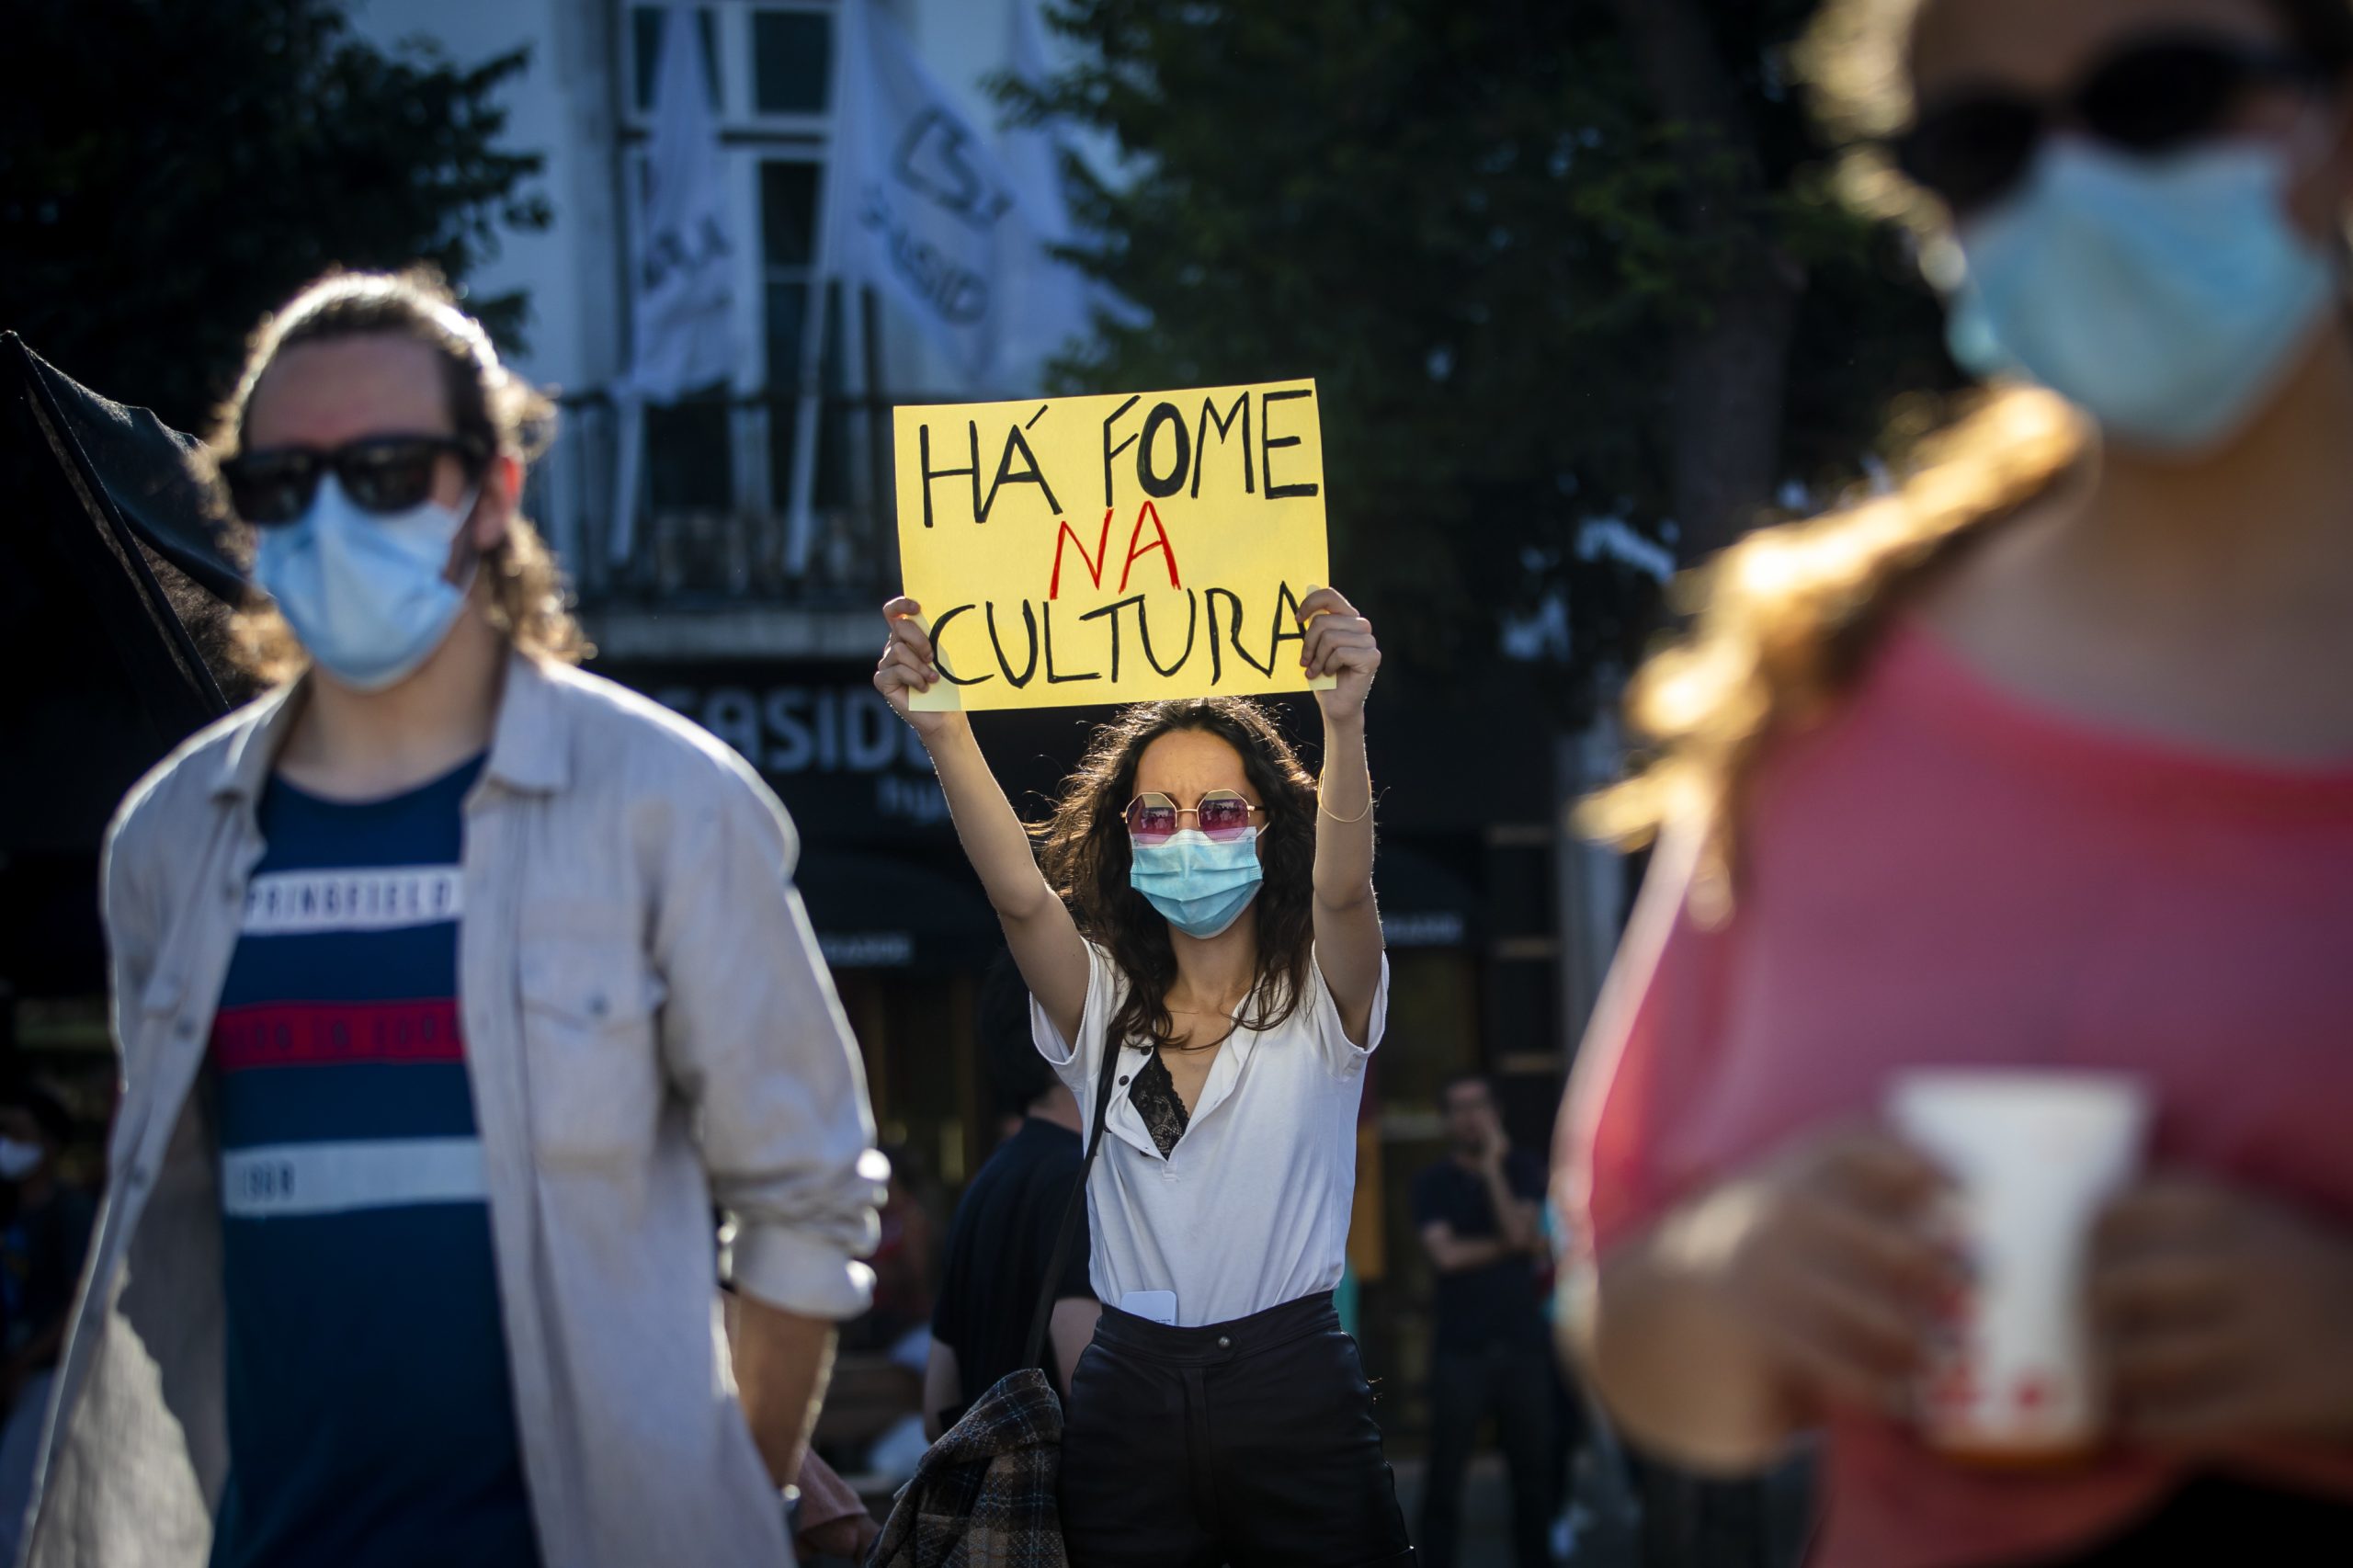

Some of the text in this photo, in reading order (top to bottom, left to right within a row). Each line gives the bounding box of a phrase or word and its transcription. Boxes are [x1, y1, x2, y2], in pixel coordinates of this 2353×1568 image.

[919, 389, 1319, 528] HÁ FOME
[1050, 500, 1181, 600] NA
[930, 580, 1307, 689] CULTURA
